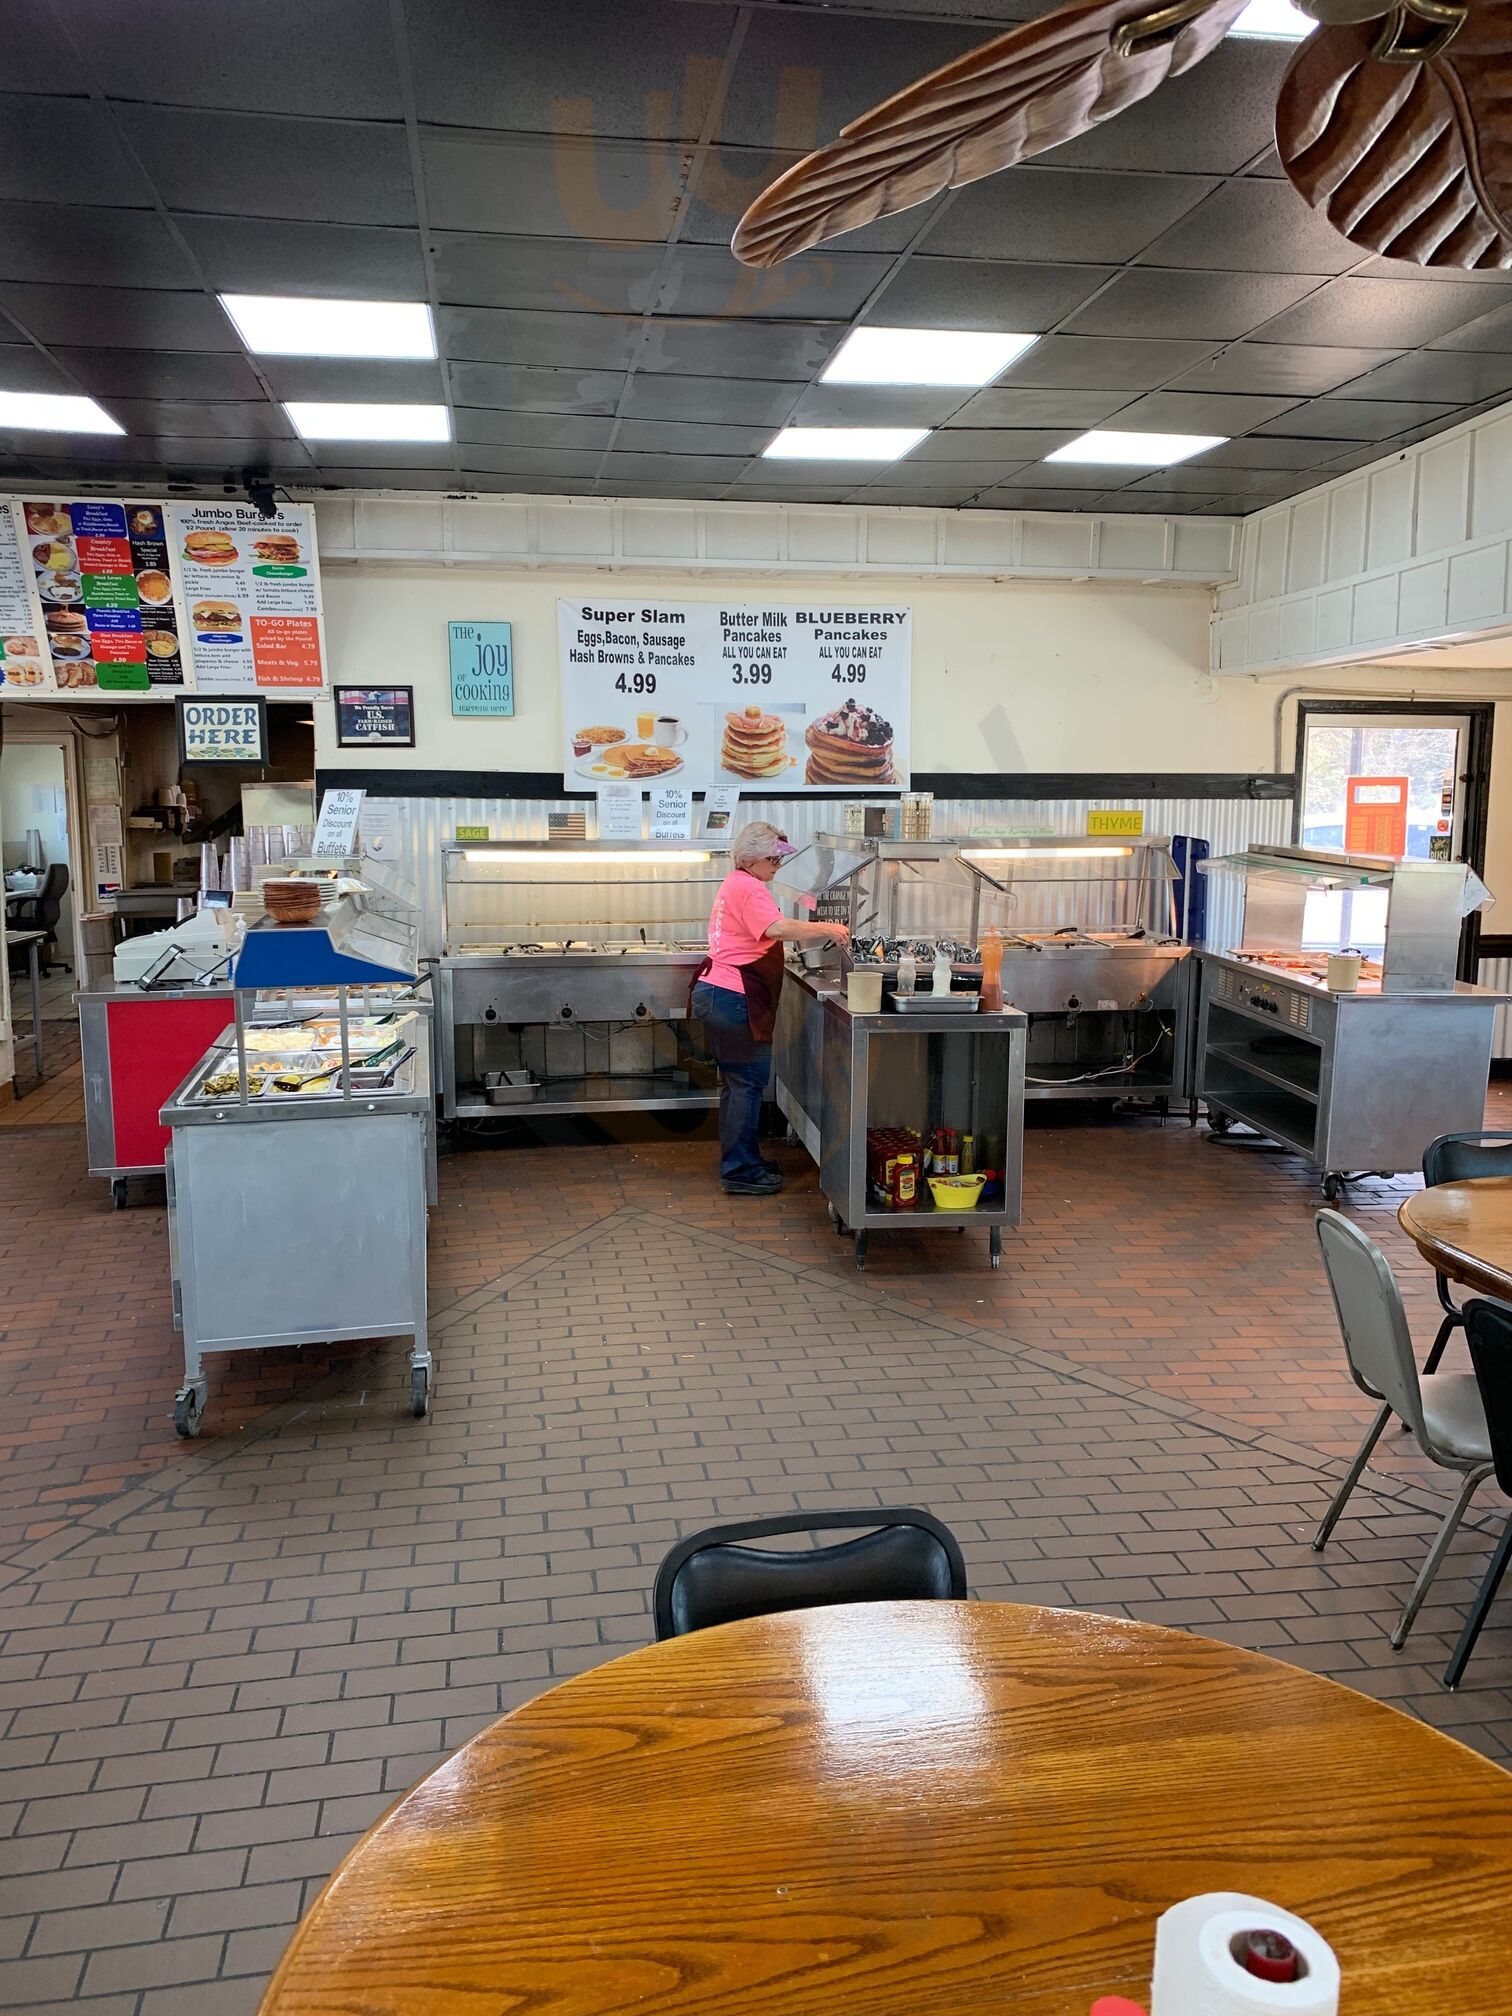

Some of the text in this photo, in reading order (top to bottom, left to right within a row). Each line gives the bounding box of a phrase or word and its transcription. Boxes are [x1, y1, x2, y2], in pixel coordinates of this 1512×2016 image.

[192, 508, 232, 519] Jumbo
[581, 606, 686, 626] Super Slam
[719, 611, 788, 627] Butter Milk
[795, 612, 907, 624] BLUEBERRY
[642, 632, 686, 648] Sausage
[723, 629, 782, 643] Pancakes
[814, 629, 888, 641] Pancakes
[569, 649, 695, 666] Hash Browns & Pancakes
[722, 647, 787, 659] ALL YOU CAN EAT
[819, 646, 882, 658] ALL YOU CAN EAT
[732, 663, 772, 684] 3.99
[831, 663, 866, 683] 4.99
[615, 673, 657, 694] 4.99
[186, 707, 257, 726] ORDER
[367, 711, 384, 719] U.S.
[188, 729, 256, 745] HERE
[337, 792, 353, 803] 10%
[665, 790, 682, 799] 10%
[327, 804, 356, 815] Senior
[658, 800, 687, 809] Senior
[323, 819, 352, 828] Discount
[1091, 817, 1141, 830] THYME
[459, 828, 486, 838] SAGE
[318, 842, 347, 854] Buffets
